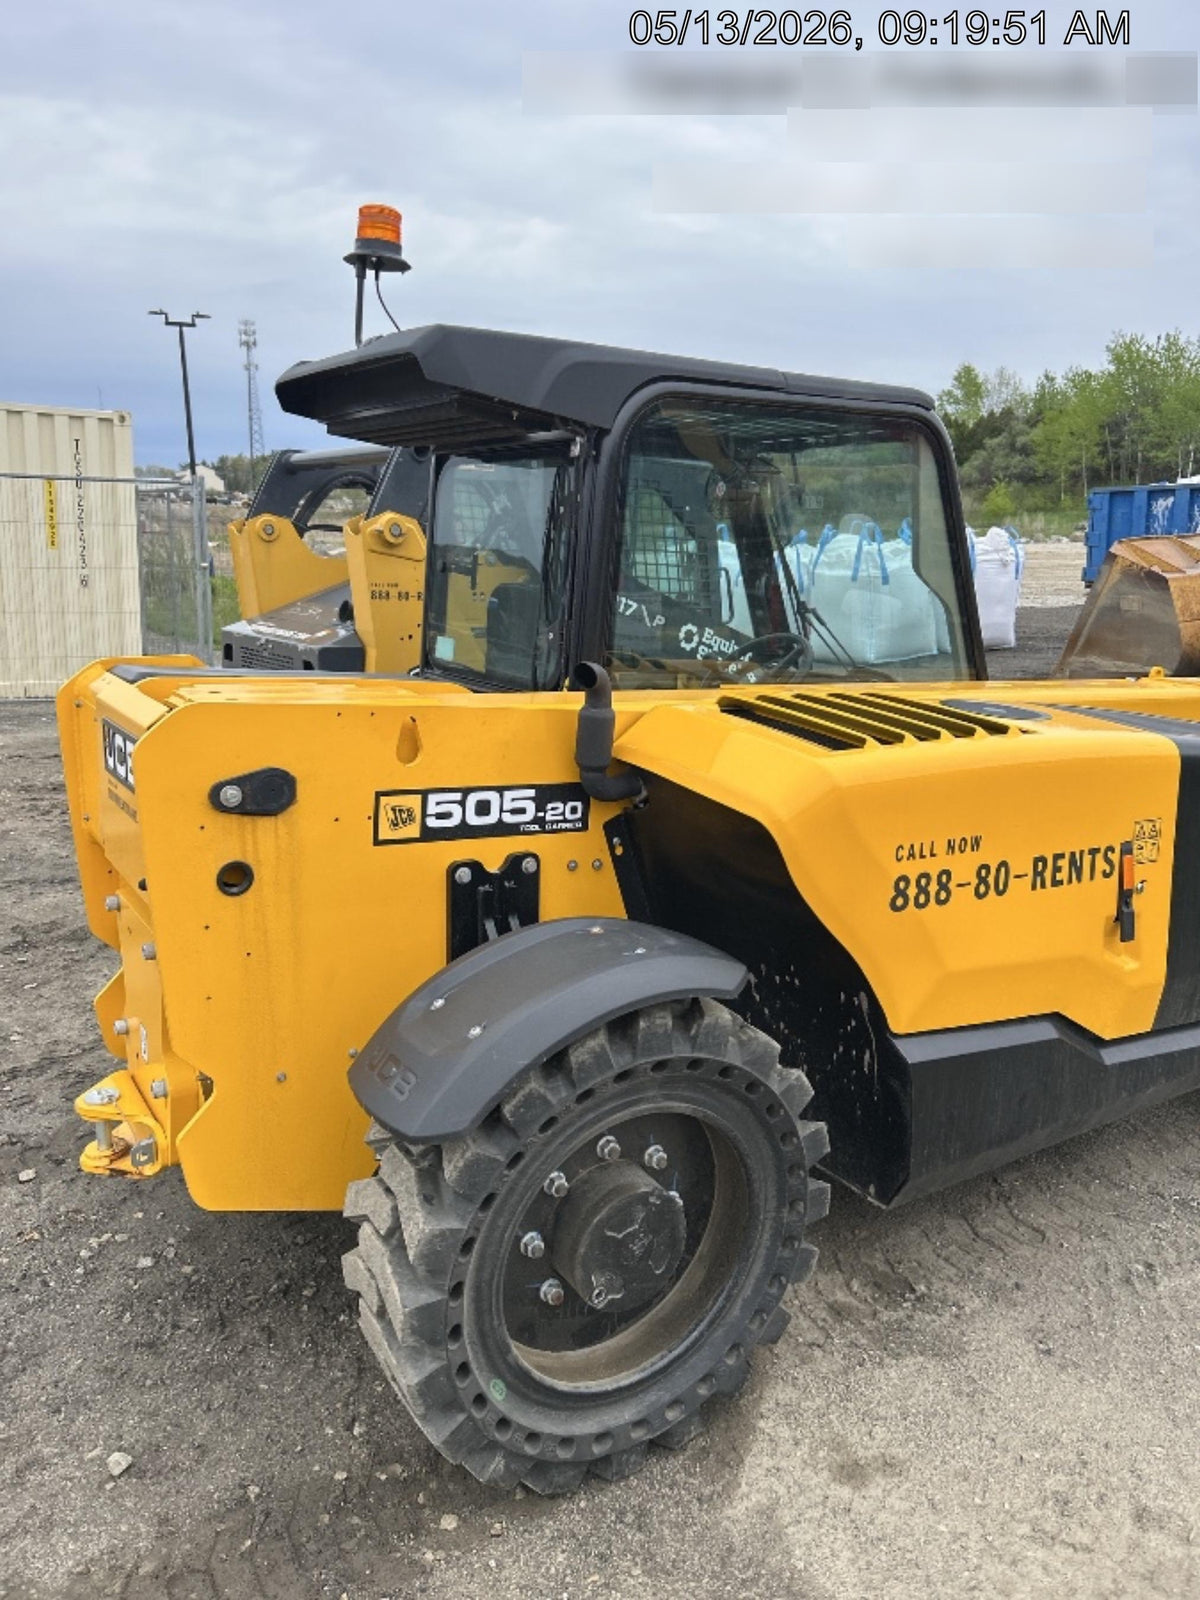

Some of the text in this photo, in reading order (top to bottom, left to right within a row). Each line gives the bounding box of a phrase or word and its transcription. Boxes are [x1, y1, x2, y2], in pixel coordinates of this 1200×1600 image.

[389, 788, 583, 829] JCB 505-20
[895, 835, 983, 862] CALL NOW
[889, 845, 1116, 913] 888-80-RENTS
[367, 1047, 418, 1102] JCB
